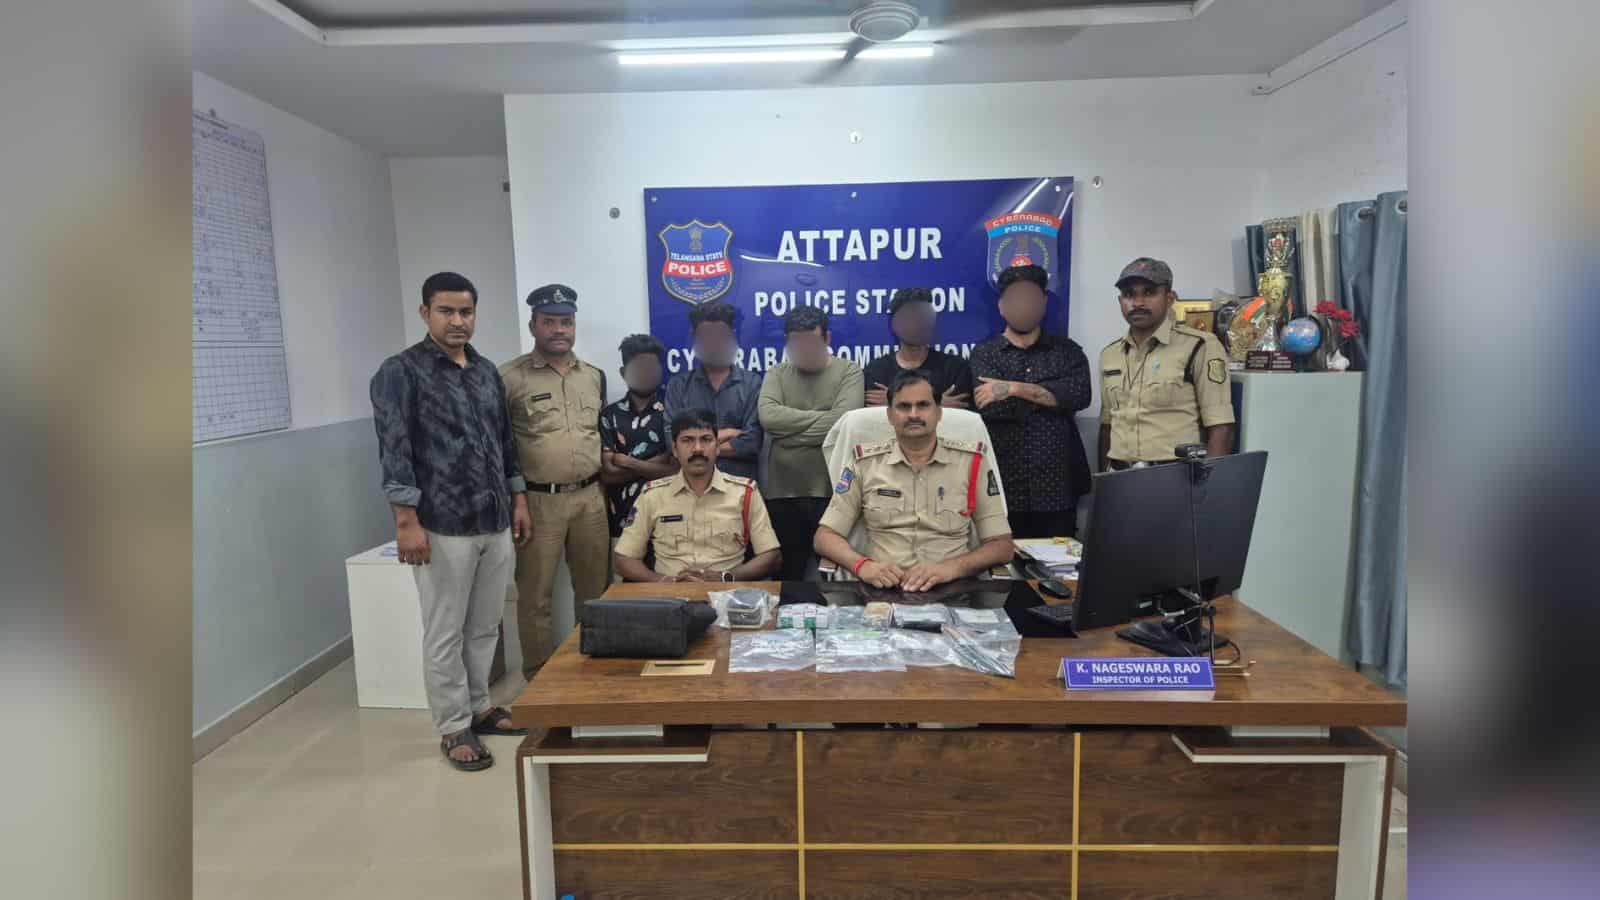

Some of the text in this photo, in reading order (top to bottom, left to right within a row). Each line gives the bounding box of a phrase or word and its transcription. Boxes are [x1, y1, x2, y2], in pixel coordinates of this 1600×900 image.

[1004, 224, 1041, 234] POLICE
[777, 227, 943, 262] ATTAPUR
[668, 261, 727, 276] POLICE
[856, 286, 965, 315] STON
[1076, 663, 1201, 674] K. NAGESWARA RAO
[1092, 676, 1189, 685] INSPECTOR OF POLICE
